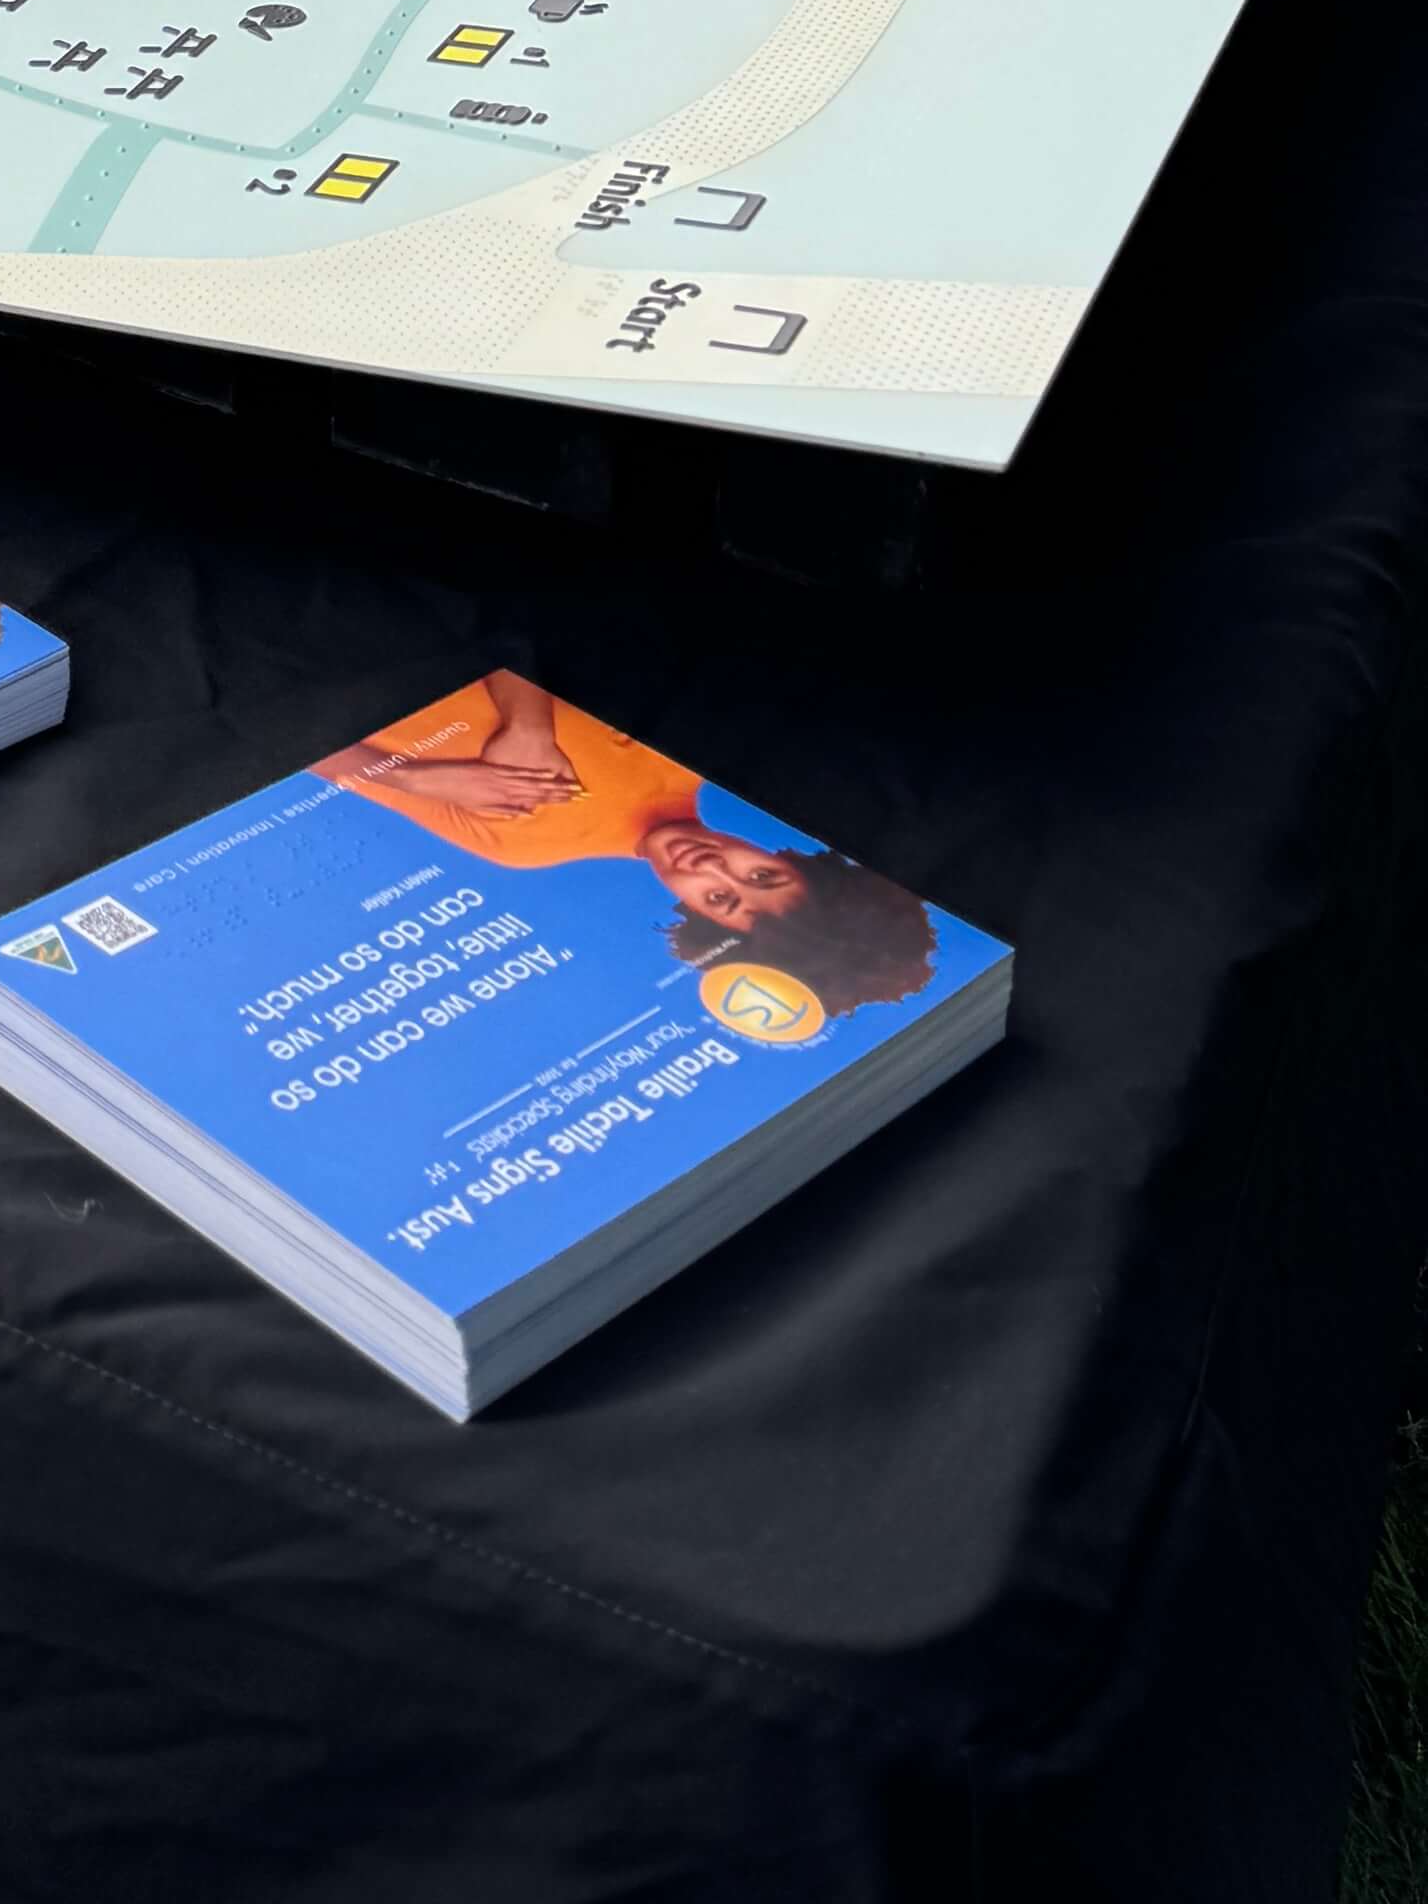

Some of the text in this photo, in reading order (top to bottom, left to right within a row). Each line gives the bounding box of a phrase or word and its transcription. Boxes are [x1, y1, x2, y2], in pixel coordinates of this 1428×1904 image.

[508, 57, 550, 69] 1
[243, 176, 291, 196] 2
[572, 159, 670, 231] Finish
[604, 277, 701, 353] Start
[357, 719, 474, 779] Quality Unity
[132, 819, 274, 893] Innovation Care
[377, 919, 424, 950] do
[418, 887, 483, 926] can
[337, 942, 382, 971] so
[265, 912, 532, 1060] little; together, we
[419, 992, 475, 1027] we
[355, 1019, 424, 1061] can
[269, 1079, 316, 1111] so
[311, 1054, 361, 1087] do
[548, 1044, 655, 1105] Wayfinding
[635, 1038, 739, 1099] Braille
[546, 1094, 654, 1155] Tactile
[464, 1147, 560, 1204] Signs
[386, 1194, 474, 1250] Aust.
